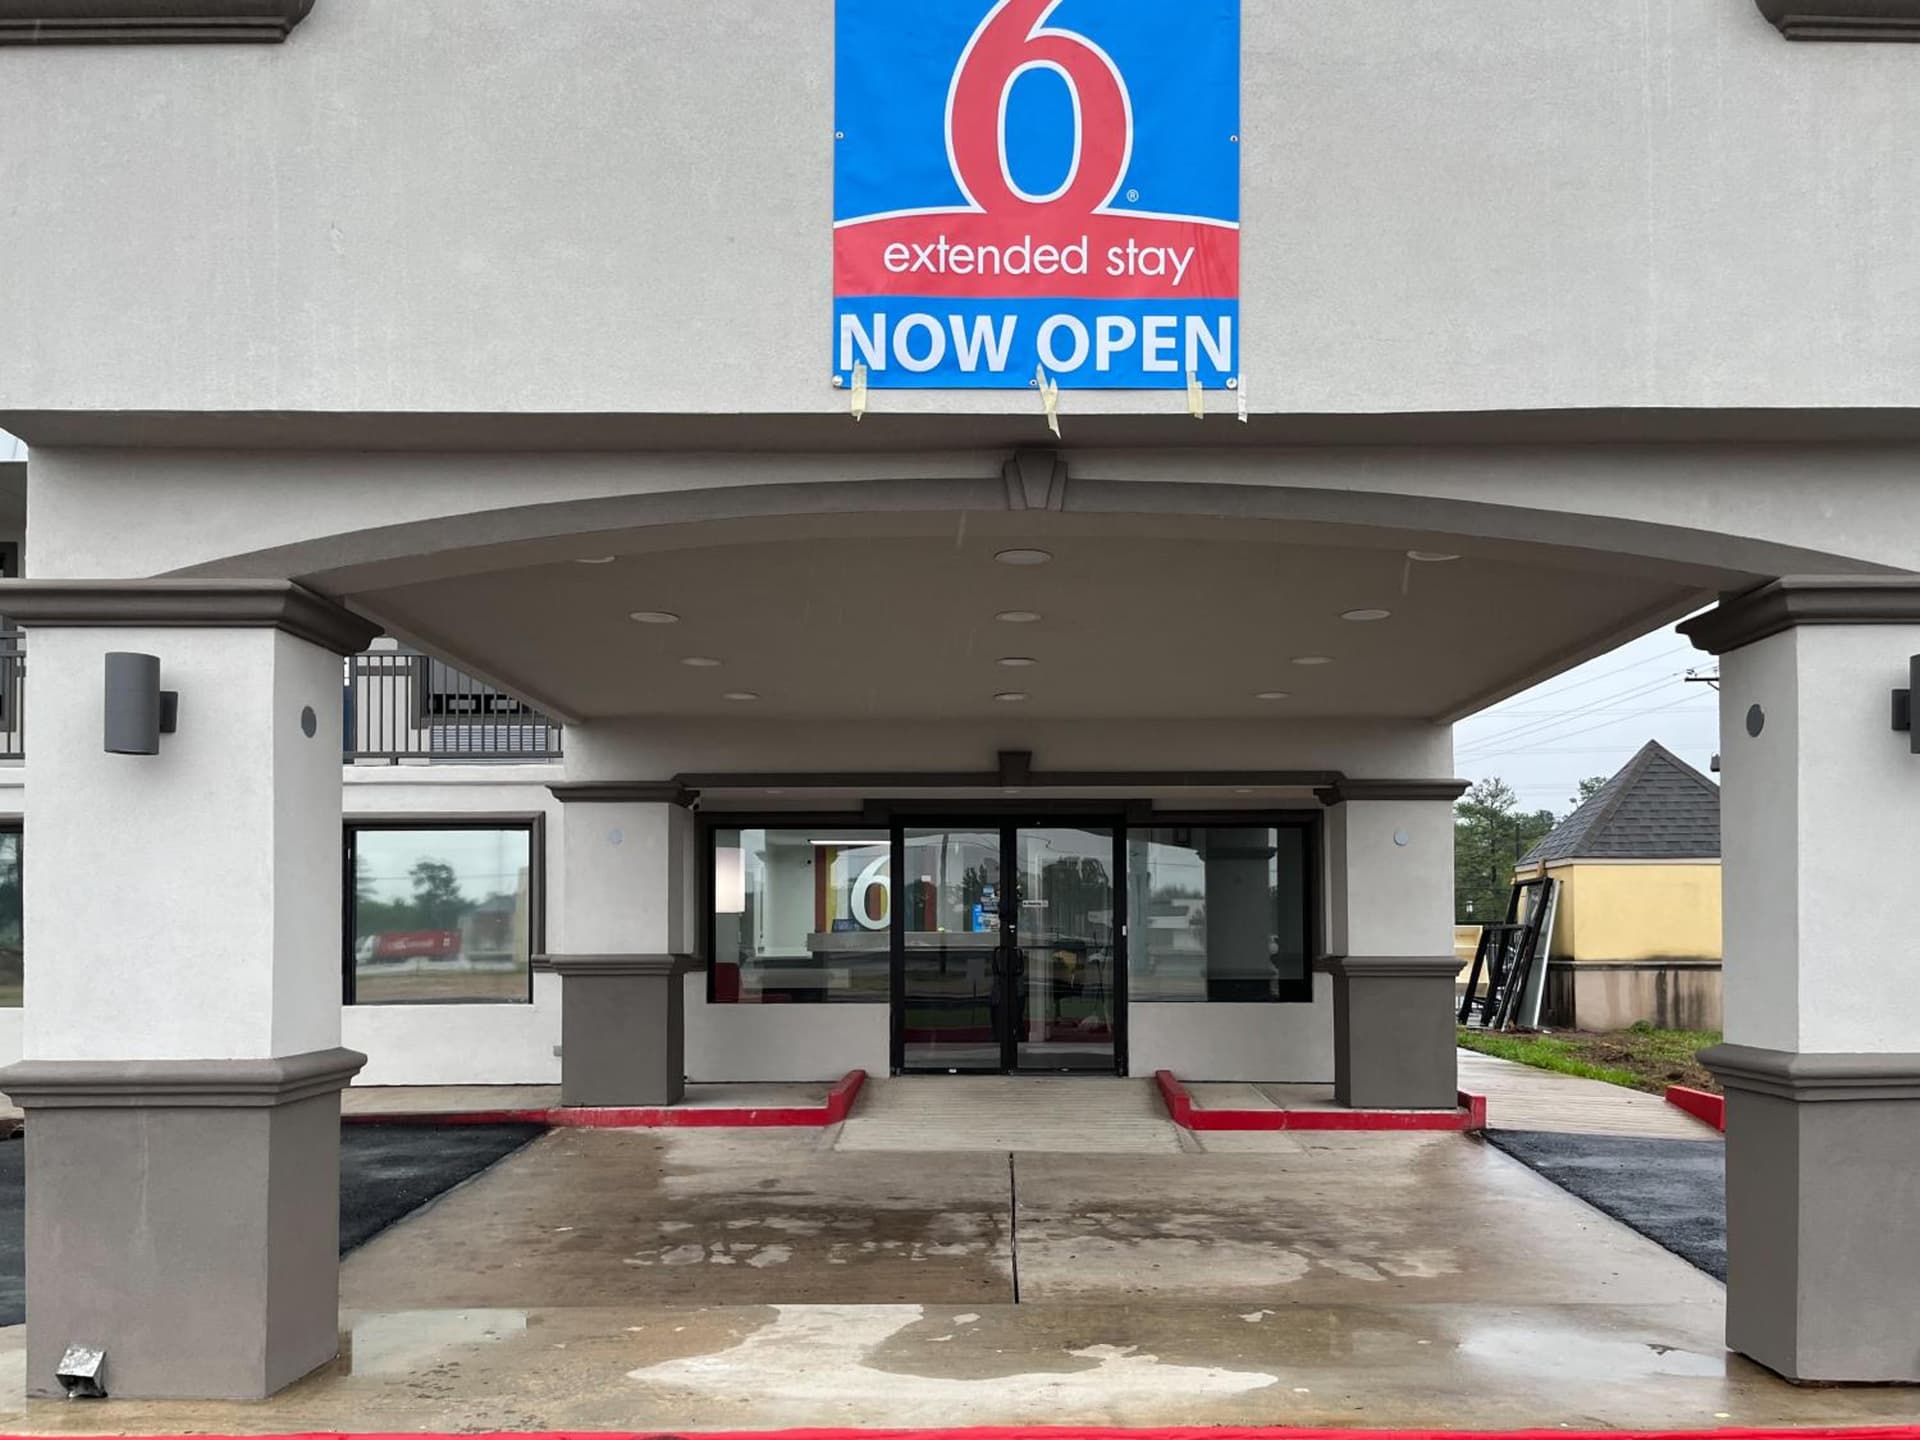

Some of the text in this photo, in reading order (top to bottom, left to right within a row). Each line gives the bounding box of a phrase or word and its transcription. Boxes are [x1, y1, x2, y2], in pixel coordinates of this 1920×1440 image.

[944, 0, 1133, 213] 6
[883, 235, 1195, 285] extended stay
[840, 313, 1231, 372] NOW OPEN
[852, 857, 890, 930] 6
